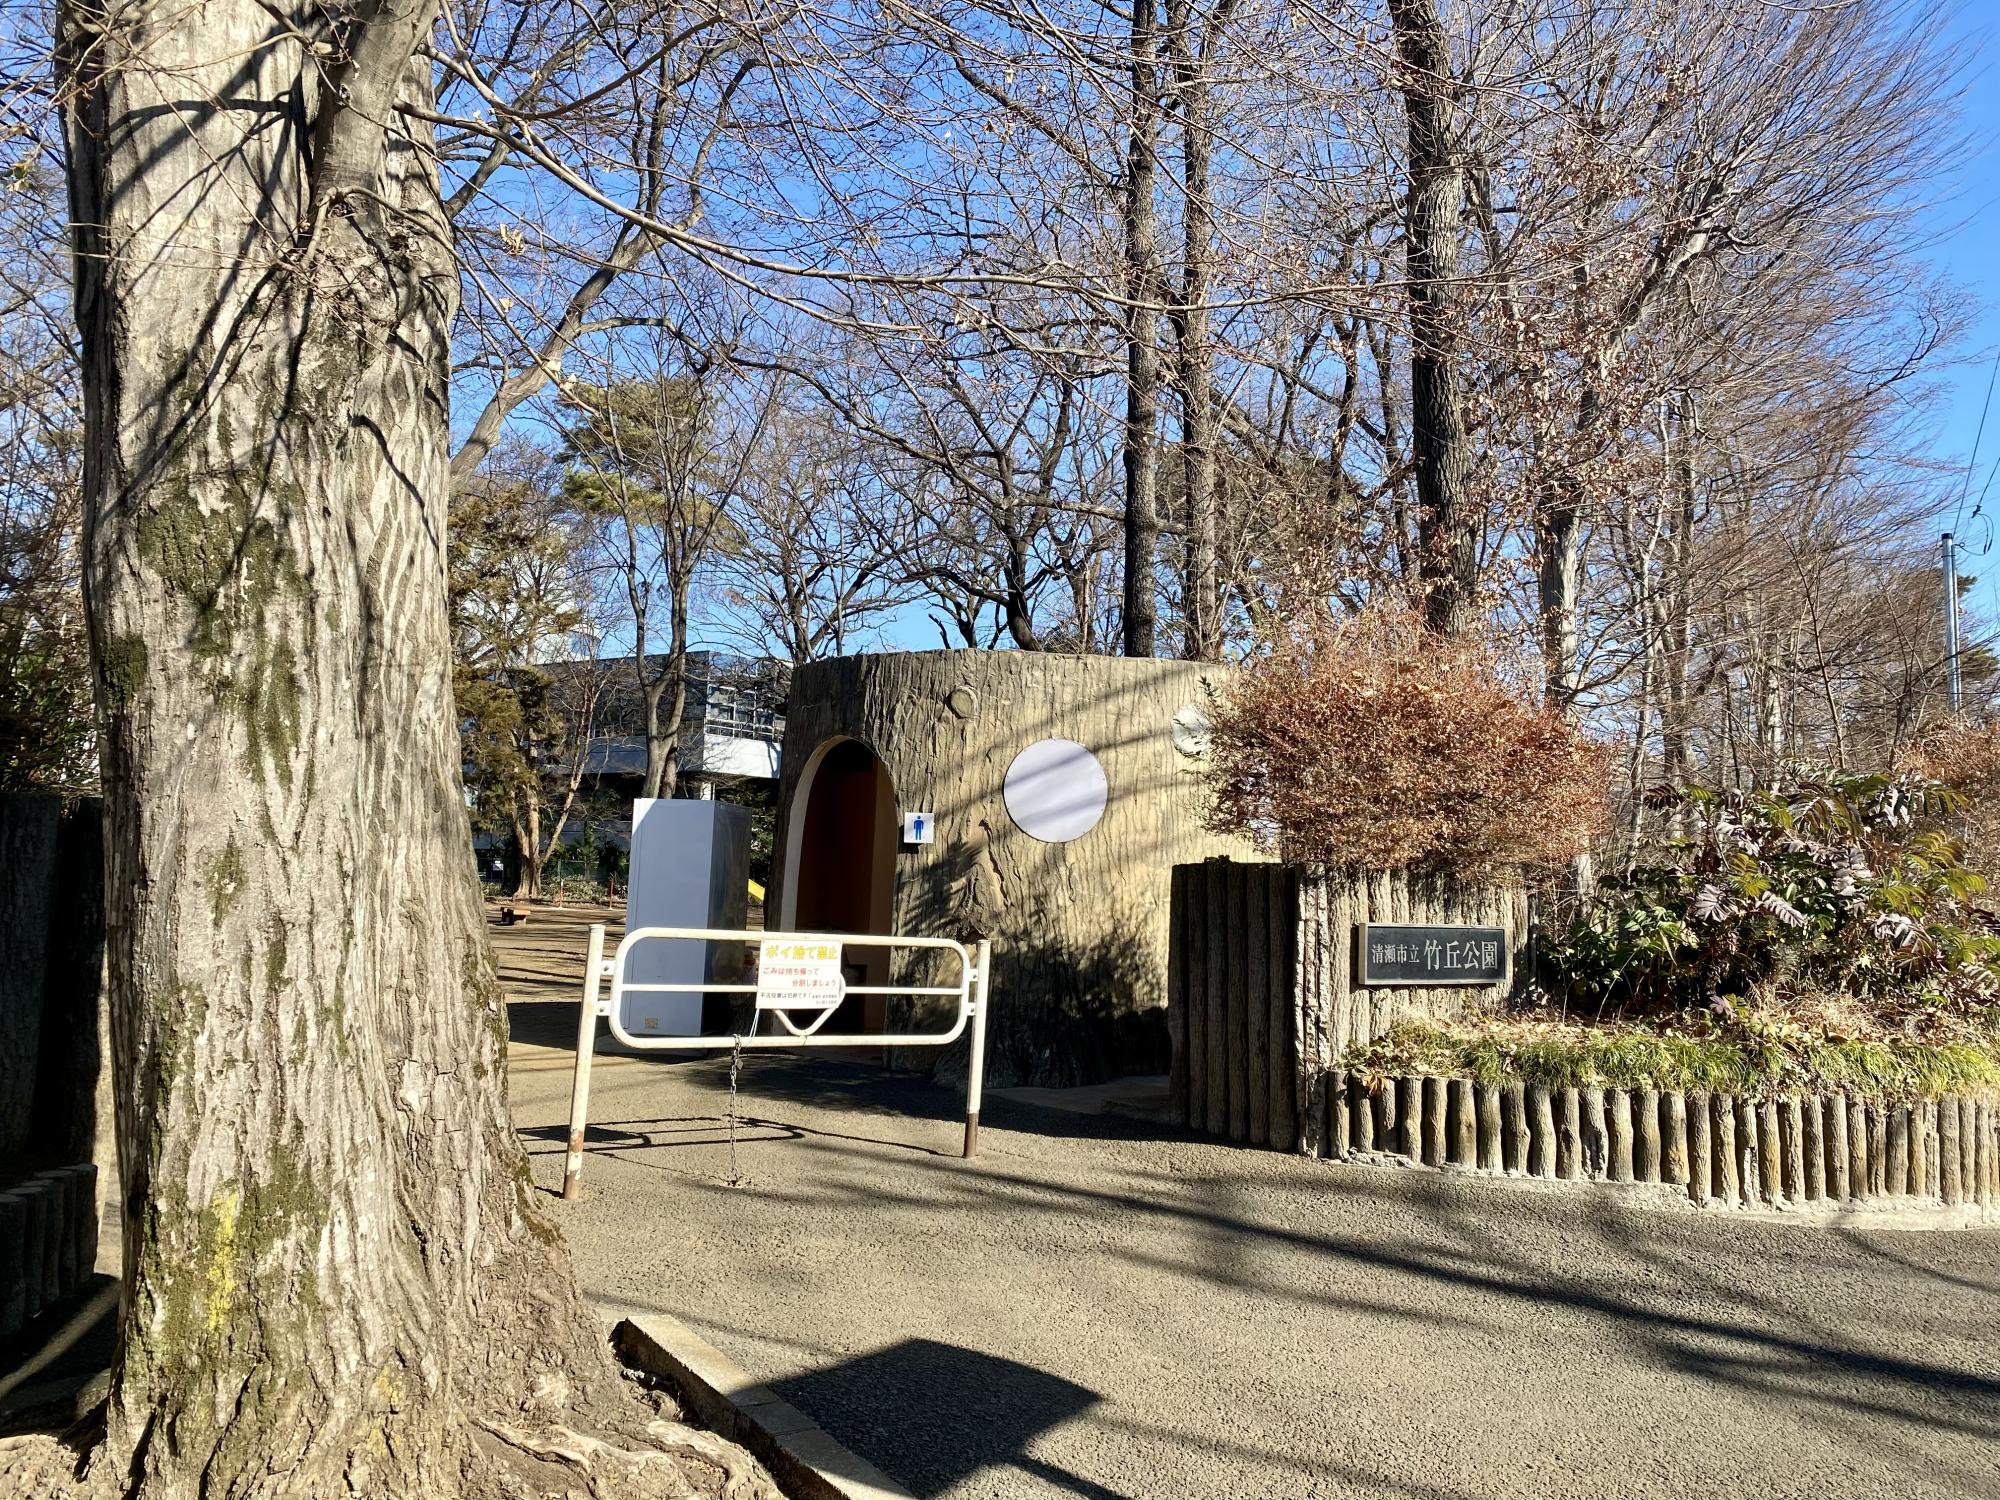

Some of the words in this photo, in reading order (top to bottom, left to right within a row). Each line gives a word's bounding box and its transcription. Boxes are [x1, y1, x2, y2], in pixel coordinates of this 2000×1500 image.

[766, 944, 838, 960] ポイ捨て禁止
